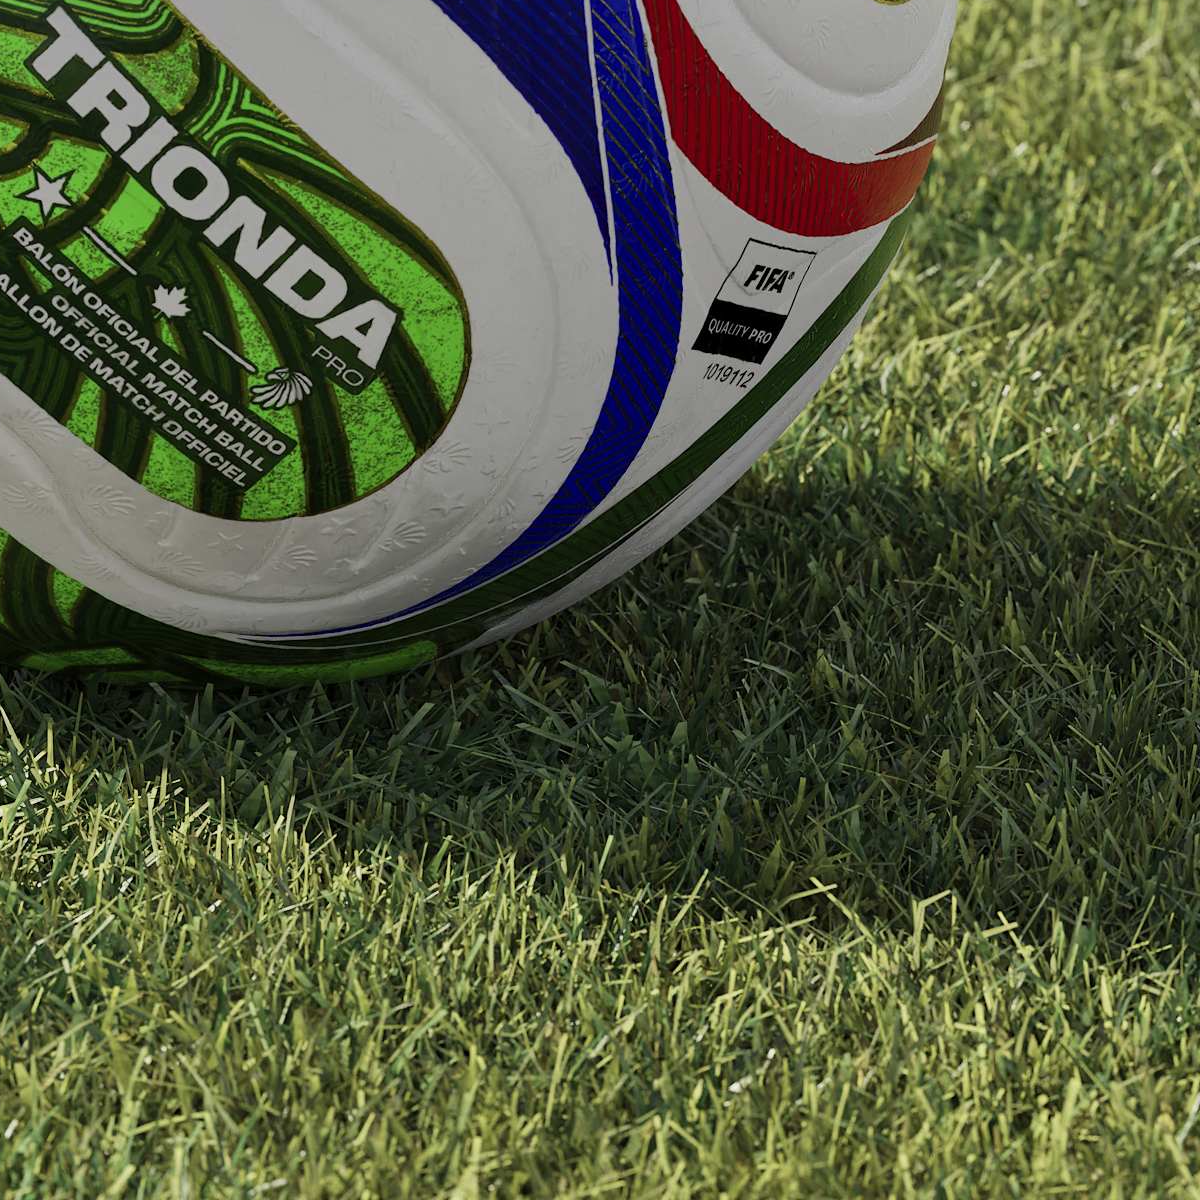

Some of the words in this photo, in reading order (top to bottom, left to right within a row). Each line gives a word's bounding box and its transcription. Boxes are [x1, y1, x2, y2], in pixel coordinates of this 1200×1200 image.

[31, 6, 398, 369] TRIONDA
[13, 227, 86, 295] BALÓN
[83, 292, 159, 363] OFICIAL
[159, 358, 199, 395] DEL
[199, 389, 287, 456] PARTIDO
[51, 295, 139, 376] OFFICIAL
[141, 373, 218, 435] MATCH
[214, 430, 264, 472] BALL
[312, 345, 364, 386] PRO
[703, 363, 755, 388] 1019112
[708, 318, 750, 338] QUALITY
[748, 328, 773, 344] PRO
[59, 333, 93, 362] DE
[89, 358, 166, 422] MATCH
[162, 420, 247, 487] OFFICIEL
